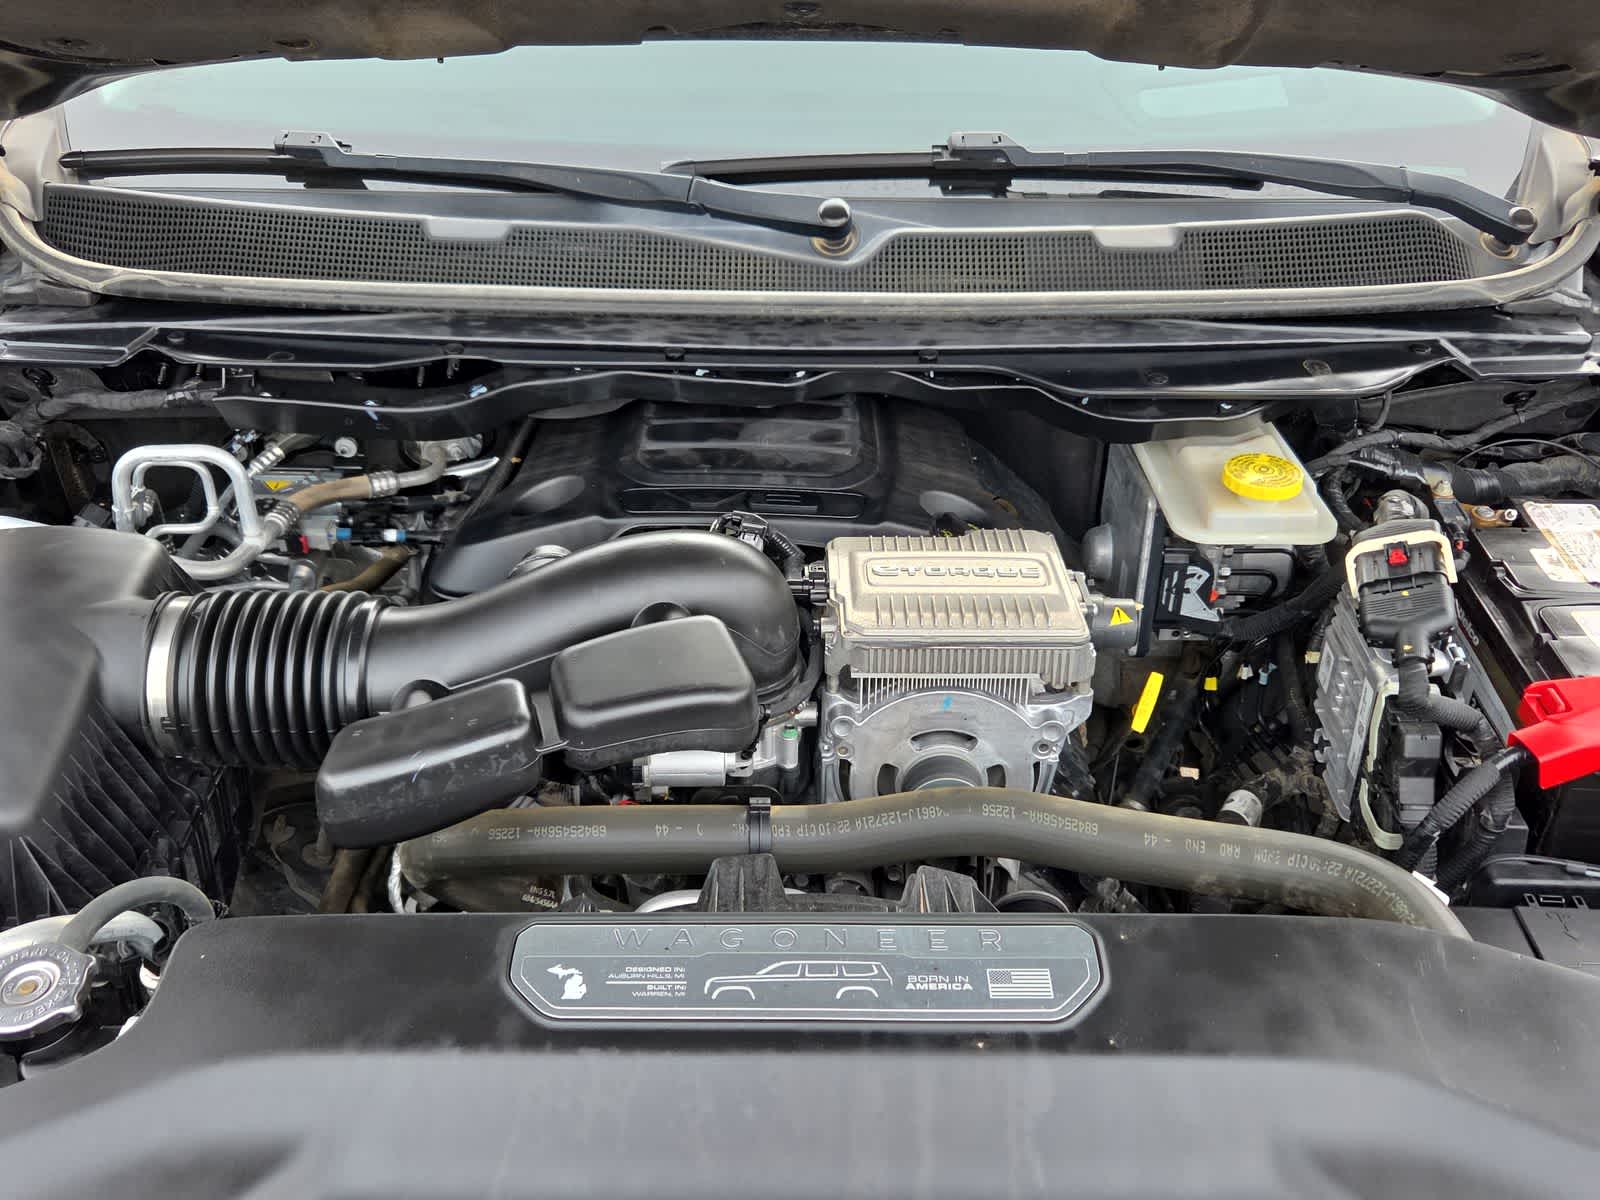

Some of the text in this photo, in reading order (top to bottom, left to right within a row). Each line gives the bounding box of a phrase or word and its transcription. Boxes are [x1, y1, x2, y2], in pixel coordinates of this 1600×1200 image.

[613, 927, 1003, 951] WAGONEER
[907, 975, 969, 983] BORN IN
[905, 983, 974, 991] AMERICA
